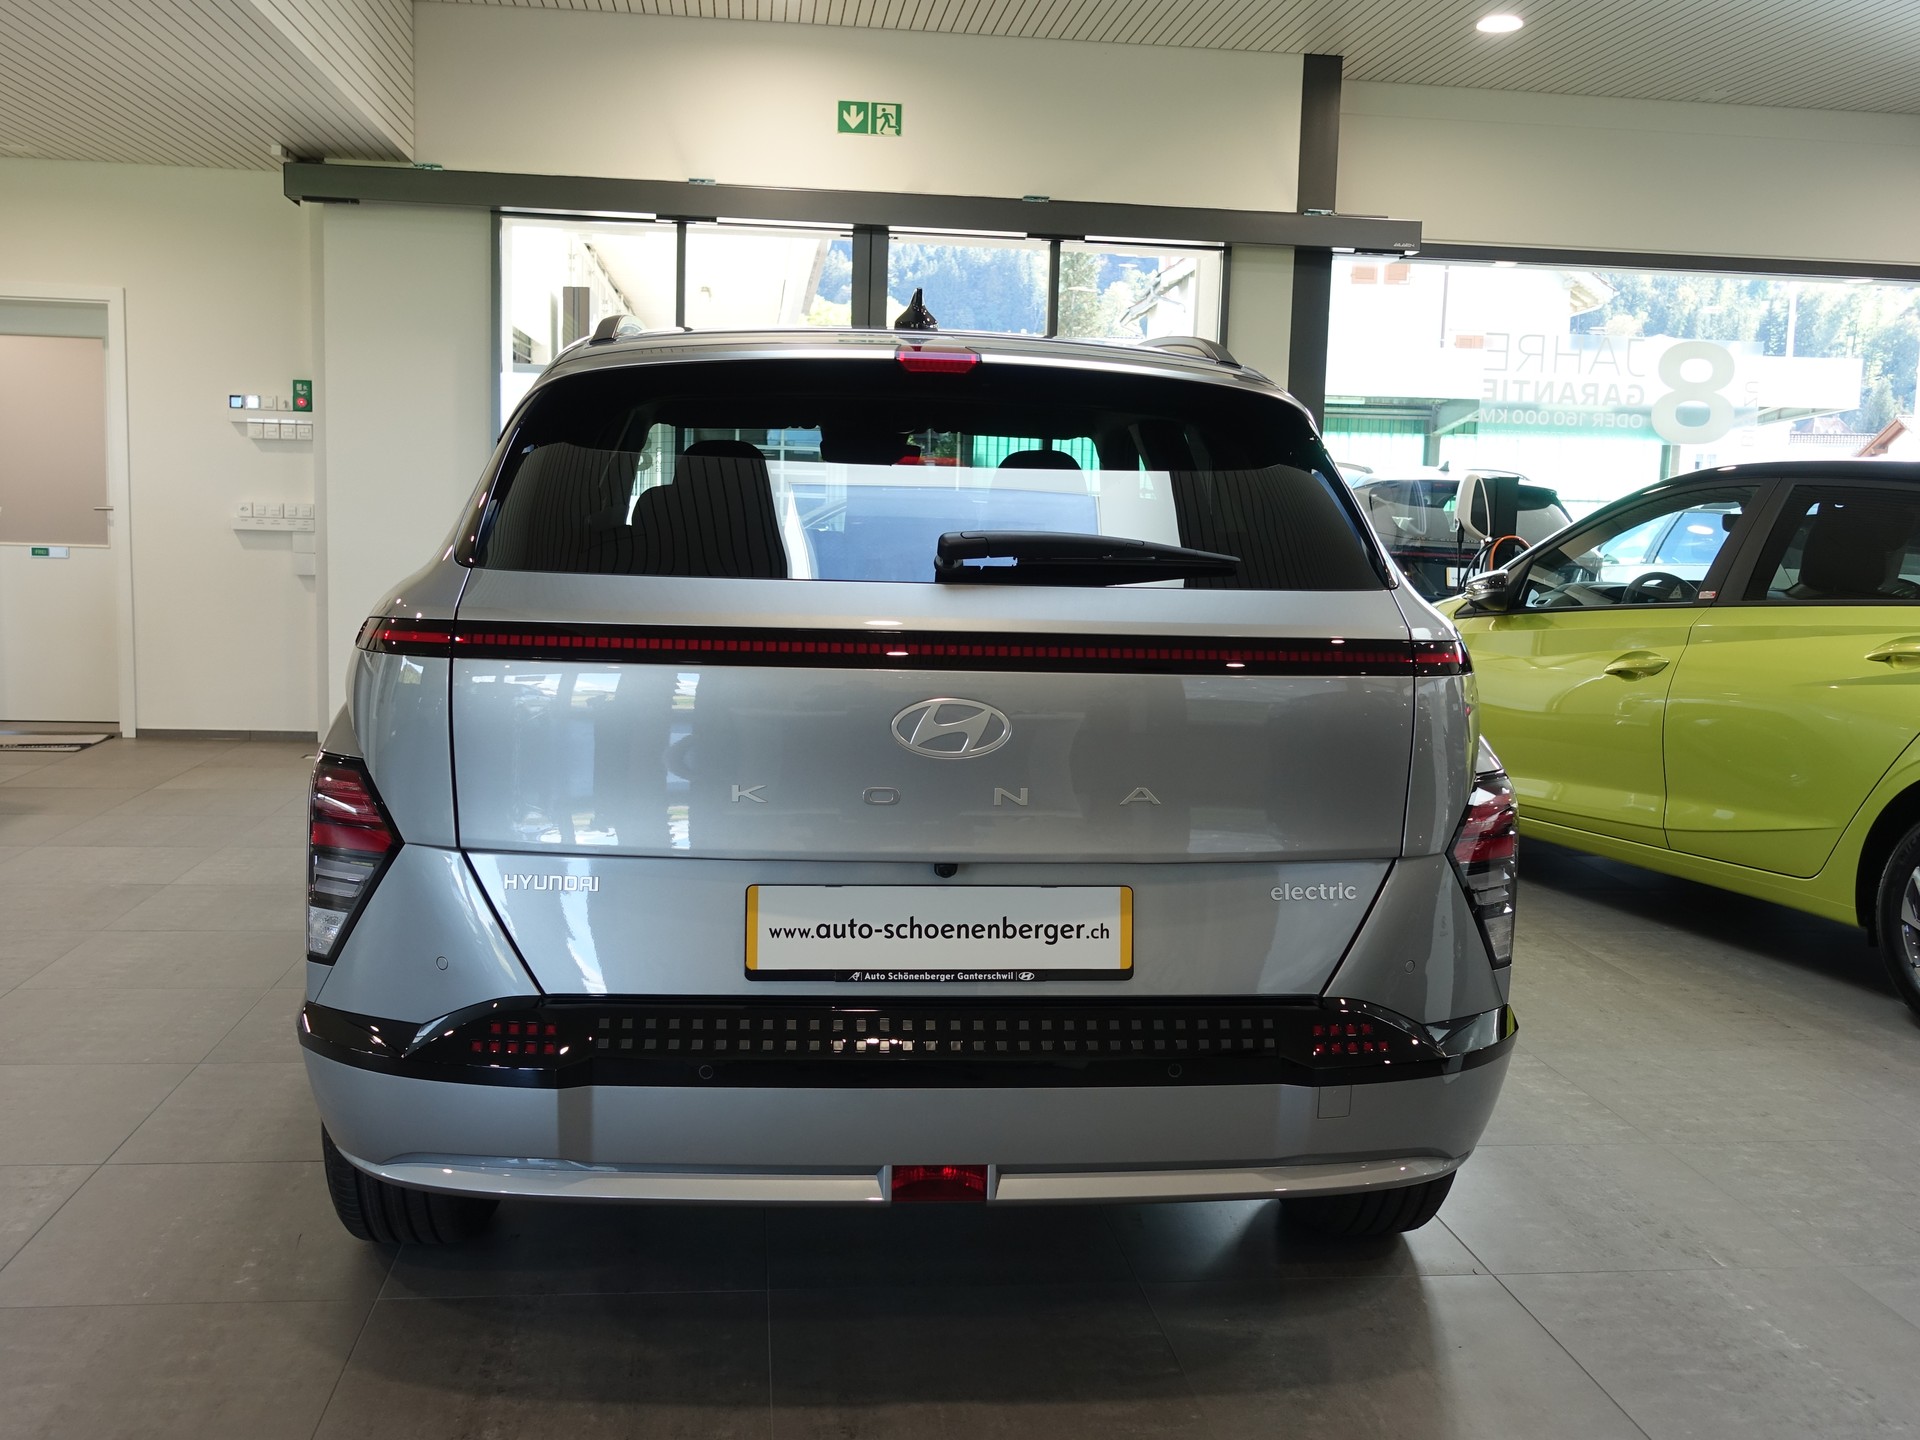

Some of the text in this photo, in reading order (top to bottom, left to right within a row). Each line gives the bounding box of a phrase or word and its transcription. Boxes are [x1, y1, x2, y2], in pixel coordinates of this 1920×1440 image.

[731, 784, 1161, 807] KONA
[503, 873, 600, 892] HYUNDAI
[1270, 882, 1357, 901] electric
[768, 916, 1110, 945] www.auto-schoenenberger.ch
[864, 971, 1014, 982] Auto Schönenberger Ganterschwil
